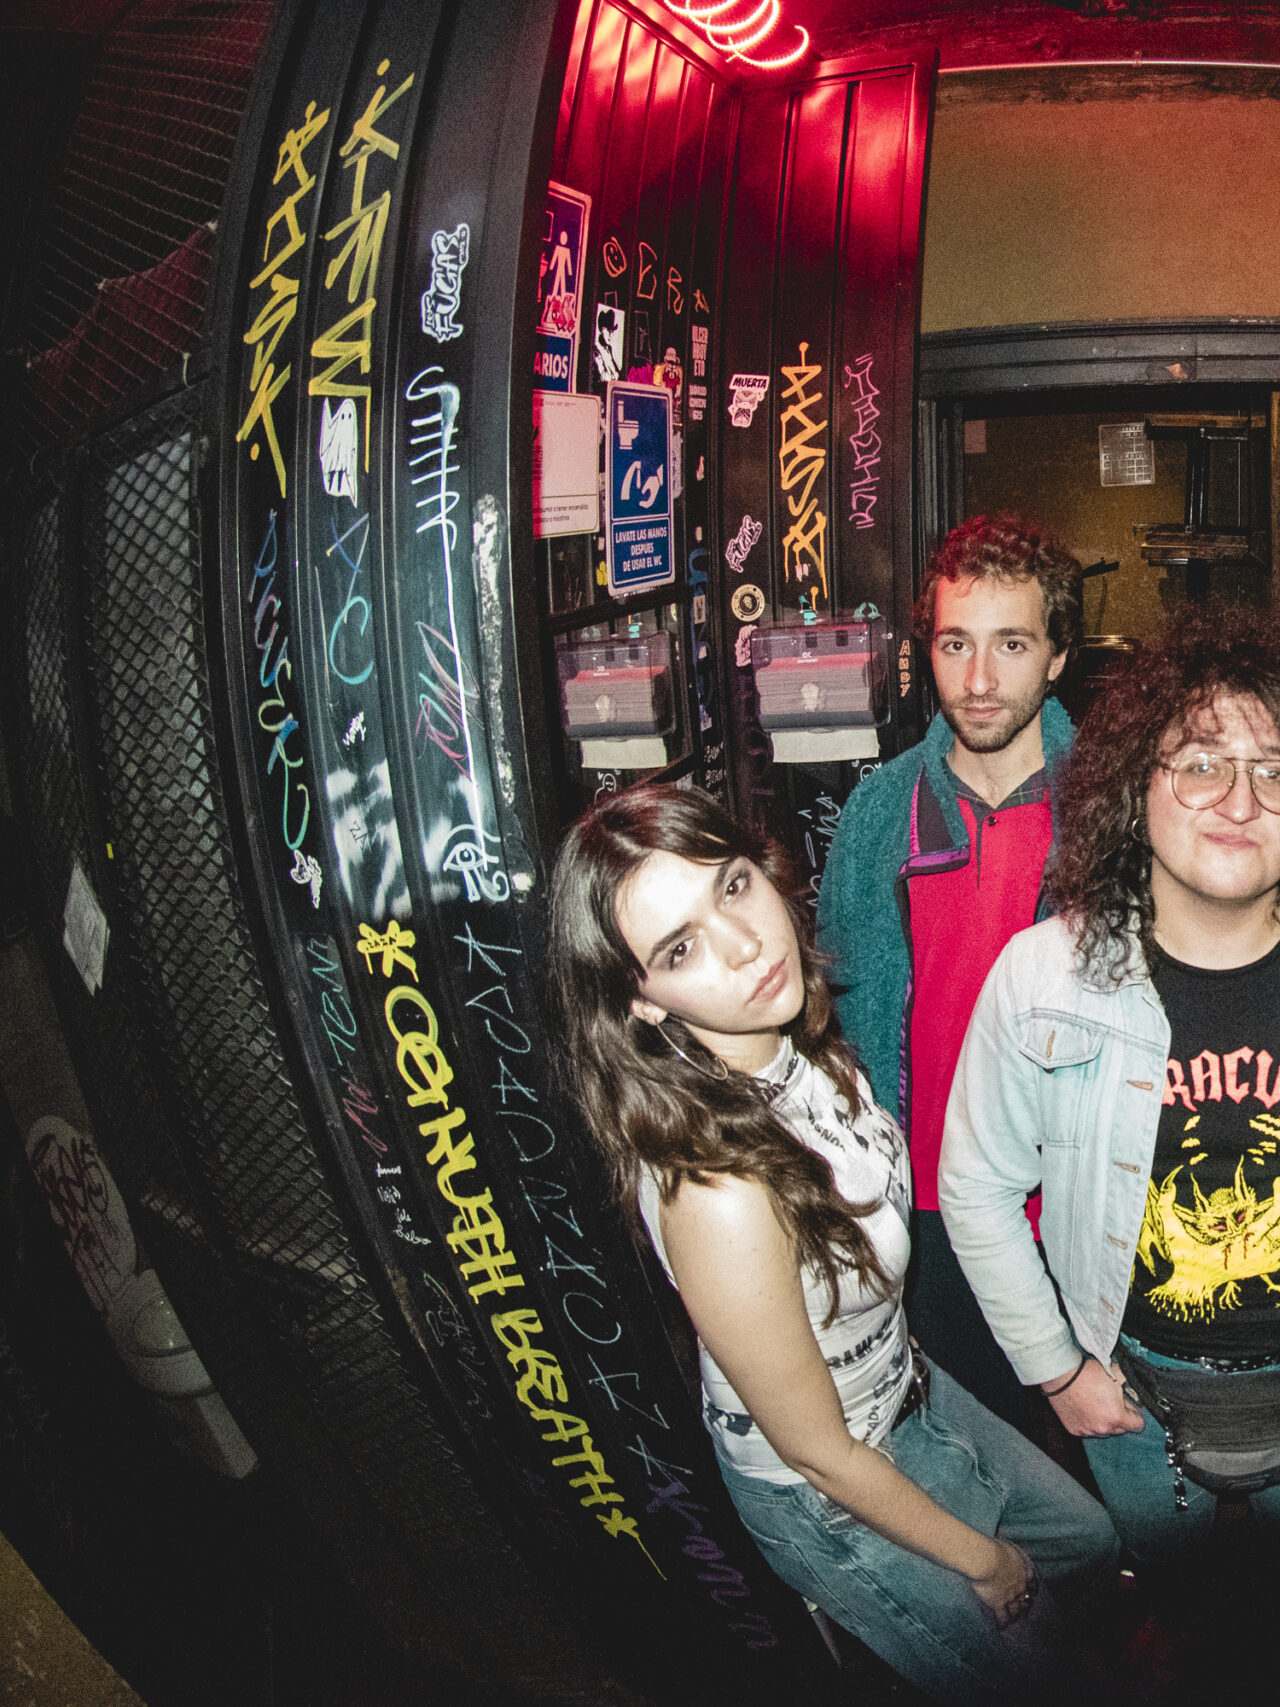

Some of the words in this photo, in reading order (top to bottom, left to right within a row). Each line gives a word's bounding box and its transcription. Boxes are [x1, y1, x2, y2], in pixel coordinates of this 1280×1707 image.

[733, 376, 768, 389] MUERTA
[615, 530, 636, 544] LAVATE
[636, 528, 647, 541] LAS
[647, 526, 668, 540] MANOS
[622, 560, 632, 572] DE
[631, 557, 646, 571] USAR
[646, 556, 653, 568] EL
[653, 554, 663, 566] WC
[898, 639, 911, 698] ANDY
[490, 1308, 626, 1510] BREATH
